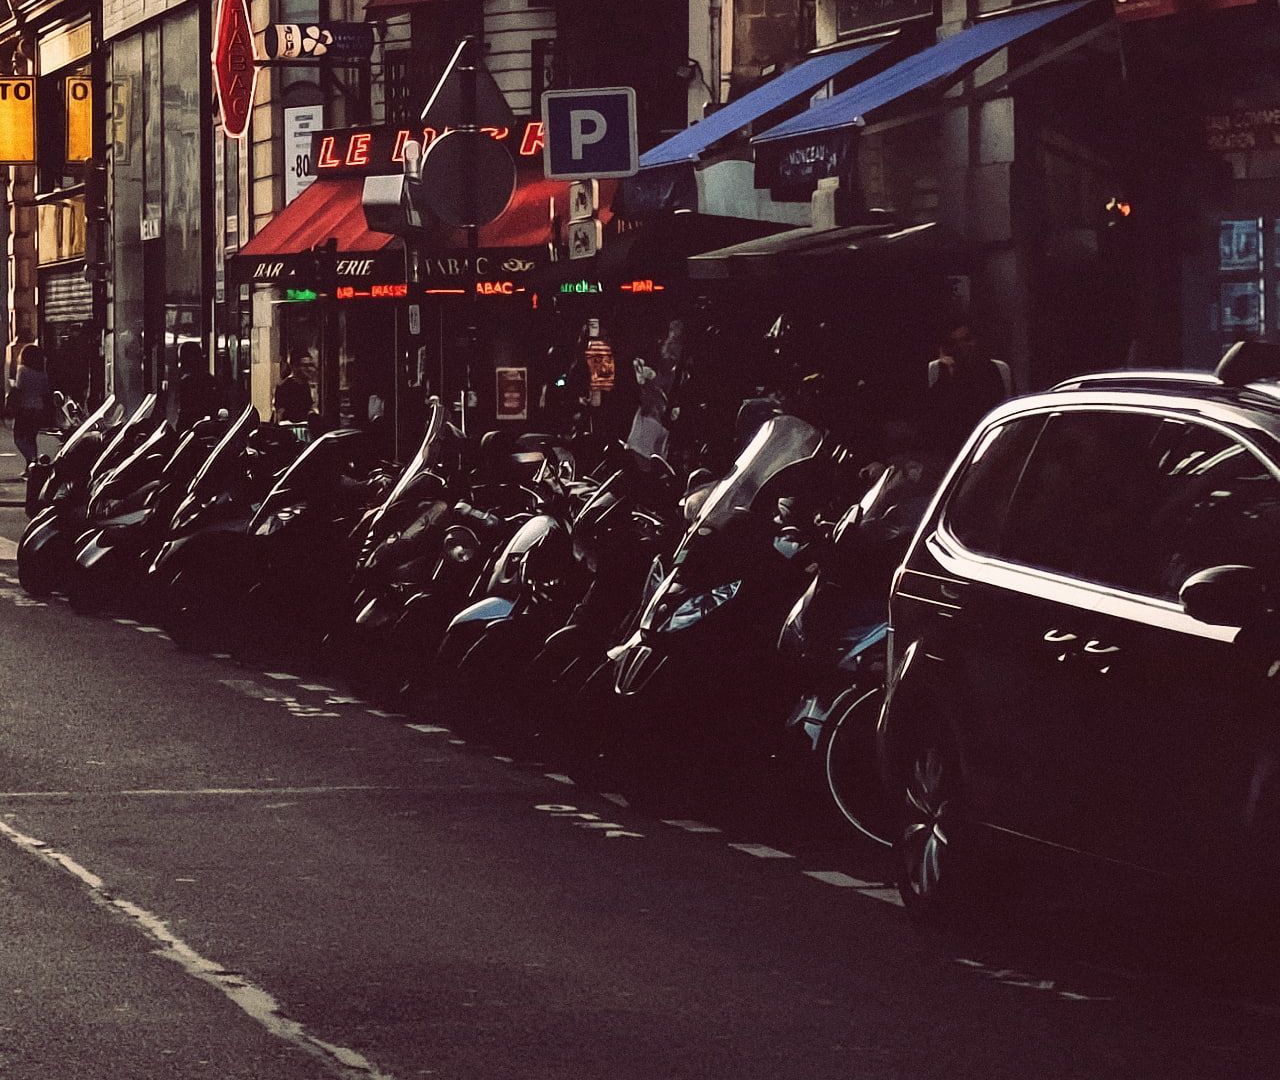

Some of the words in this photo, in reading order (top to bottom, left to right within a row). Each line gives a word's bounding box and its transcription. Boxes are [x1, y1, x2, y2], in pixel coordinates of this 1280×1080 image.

[228, 8, 248, 118] TABAC
[317, 133, 372, 168] LE
[569, 109, 608, 160] P
[253, 262, 285, 278] BAR
[476, 281, 514, 295] ABAC
